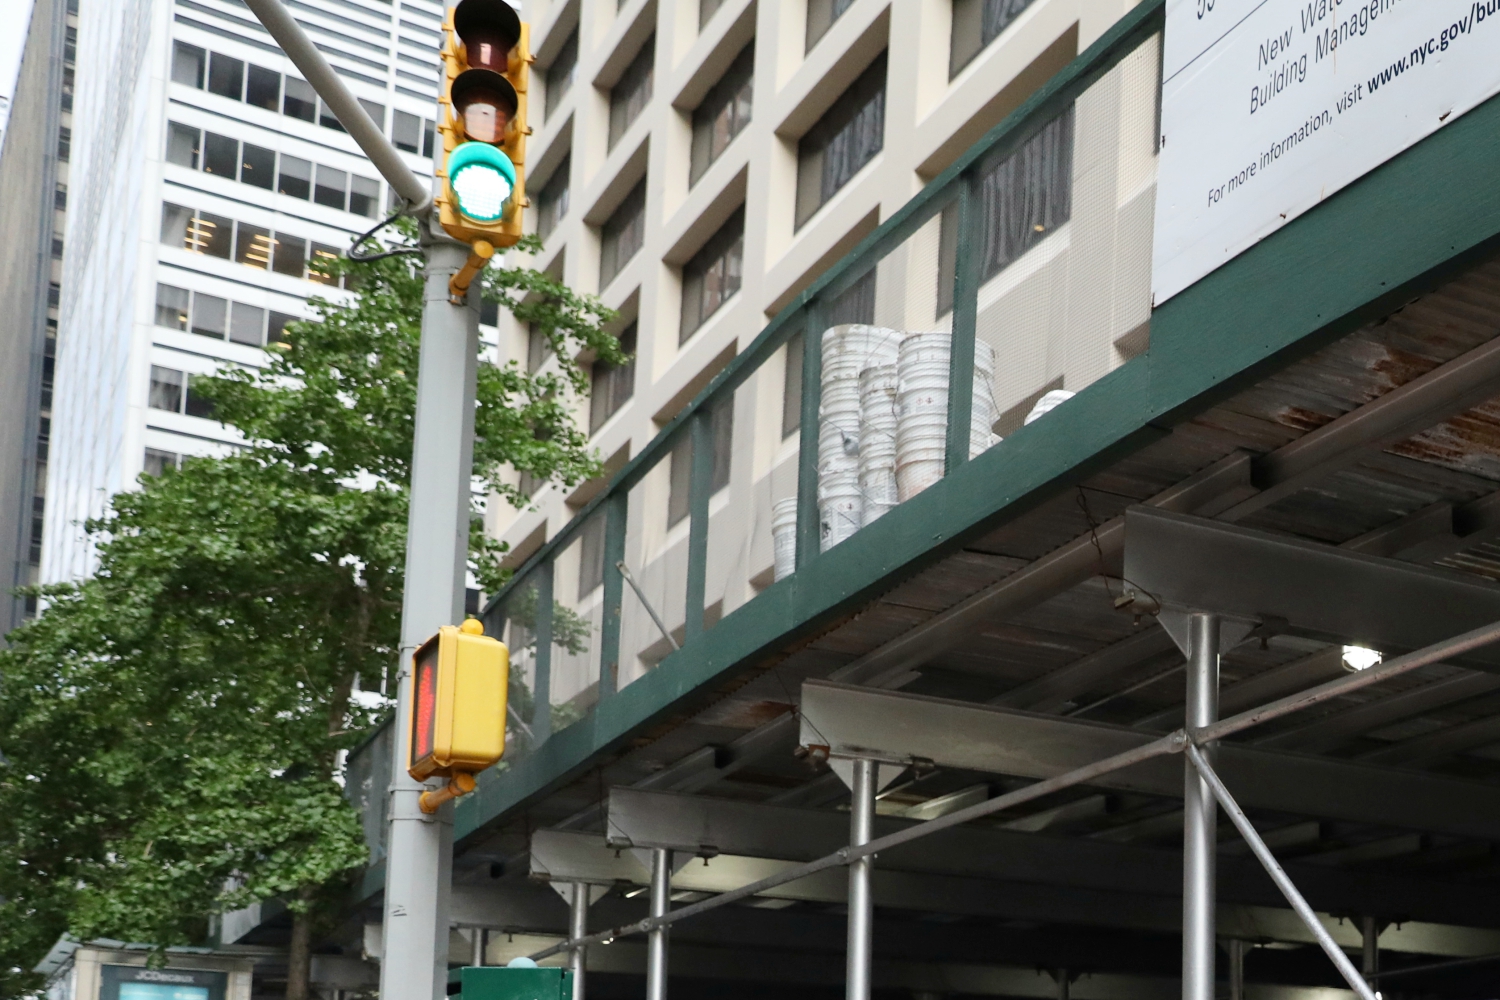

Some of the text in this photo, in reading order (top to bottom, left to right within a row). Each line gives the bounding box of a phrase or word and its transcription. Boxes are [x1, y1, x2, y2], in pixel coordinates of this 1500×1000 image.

[1258, 0, 1343, 71] New Wa
[1250, 53, 1307, 115] Building
[1208, 184, 1226, 208] For
[1228, 161, 1257, 193] more
[1260, 109, 1333, 170] information,
[1336, 83, 1363, 115] visit
